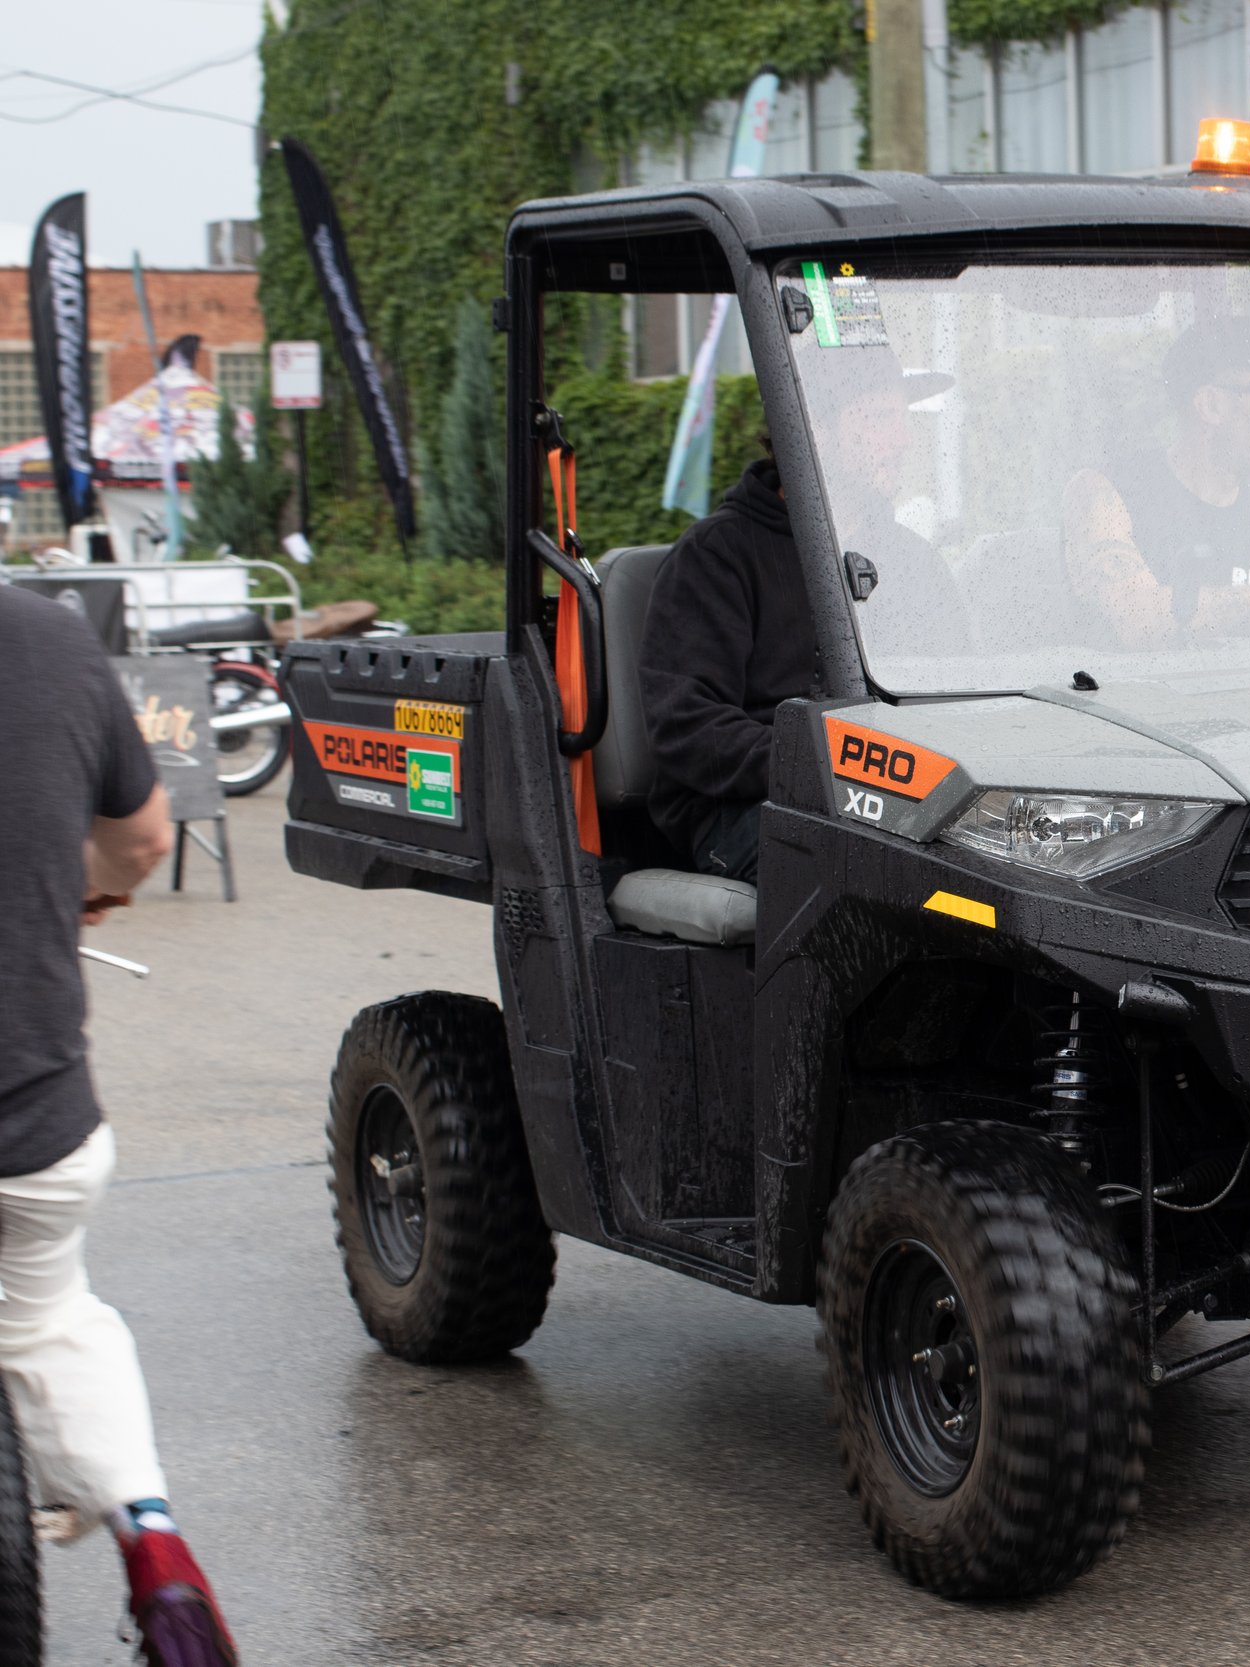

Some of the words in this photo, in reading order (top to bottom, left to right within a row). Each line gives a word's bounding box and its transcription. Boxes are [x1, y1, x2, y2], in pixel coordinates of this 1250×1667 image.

[323, 734, 407, 773] POLARIS
[839, 734, 916, 785] PRO
[844, 787, 884, 821] XD
